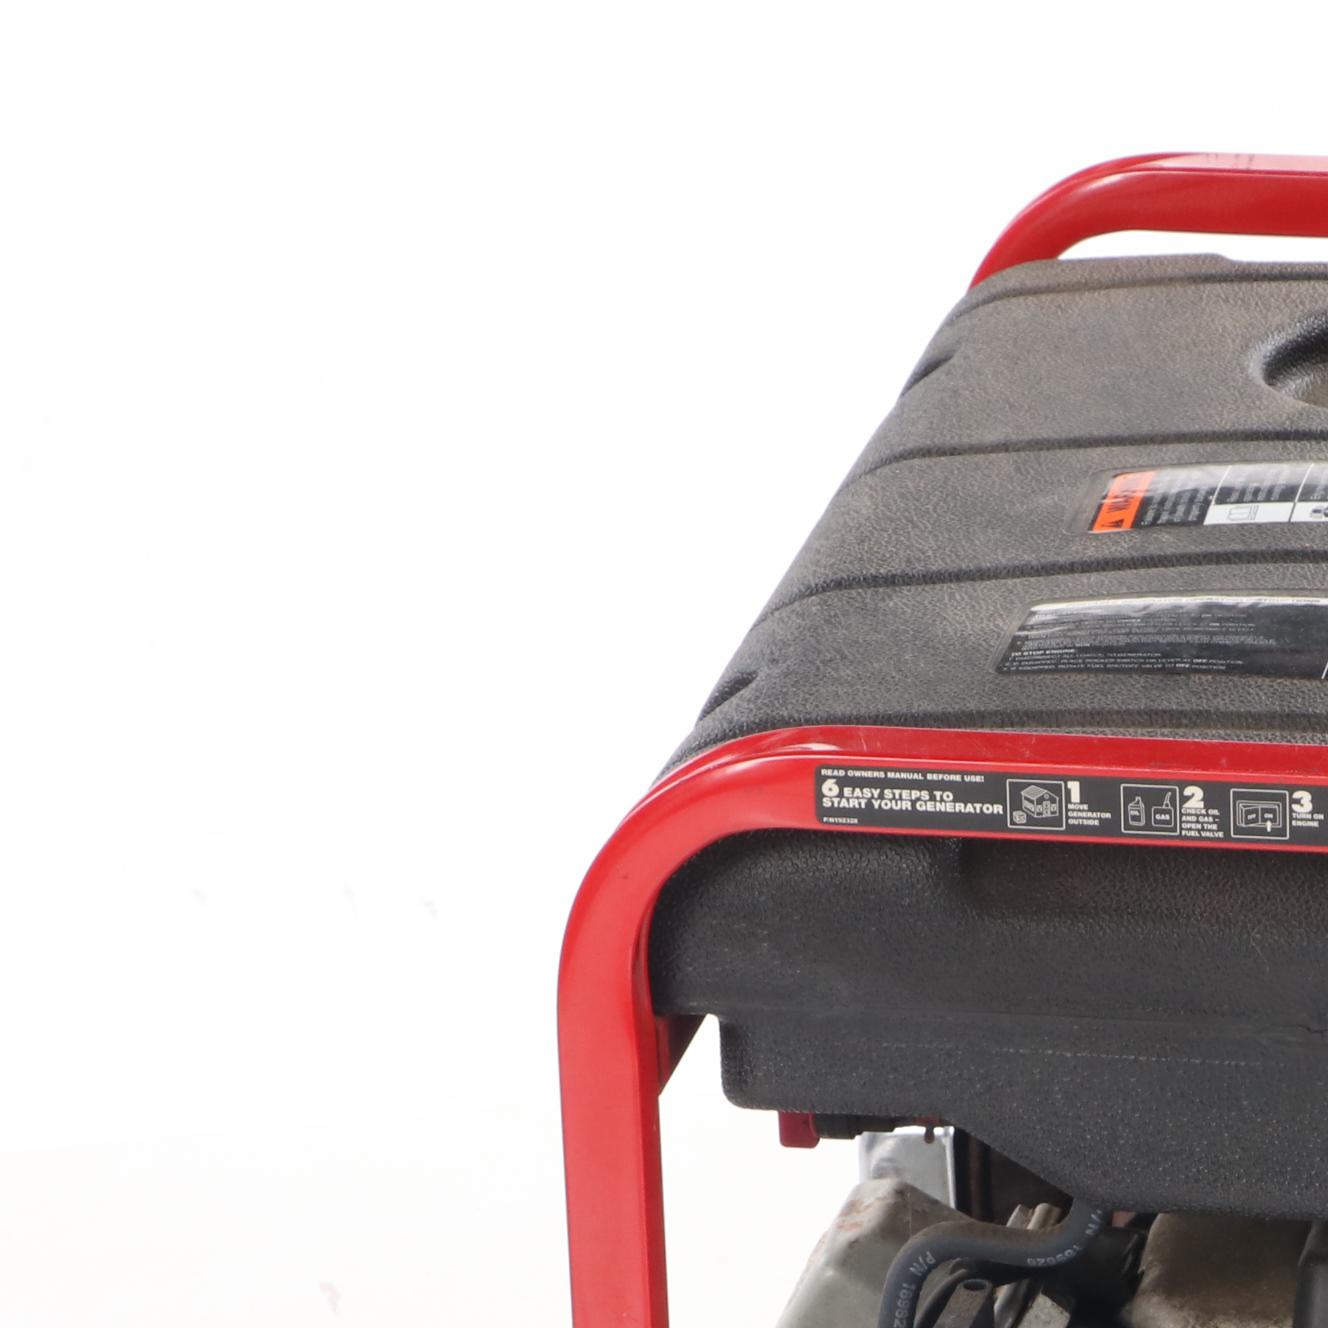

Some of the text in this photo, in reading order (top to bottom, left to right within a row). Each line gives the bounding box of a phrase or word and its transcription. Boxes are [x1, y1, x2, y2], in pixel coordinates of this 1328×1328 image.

[847, 770, 885, 778] OWNERS
[887, 771, 924, 780] MANUAL
[926, 773, 962, 781] BEFORE
[964, 775, 984, 783] USE!
[821, 778, 953, 801] 6 EASY STEPS TO
[1067, 781, 1080, 803] 1
[1182, 785, 1204, 808] 2
[822, 798, 1003, 814] START YOUR GENERATOR
[1291, 790, 1313, 813] 3
[1068, 811, 1111, 819] GENERATOR
[910, 1250, 936, 1277] P/N
